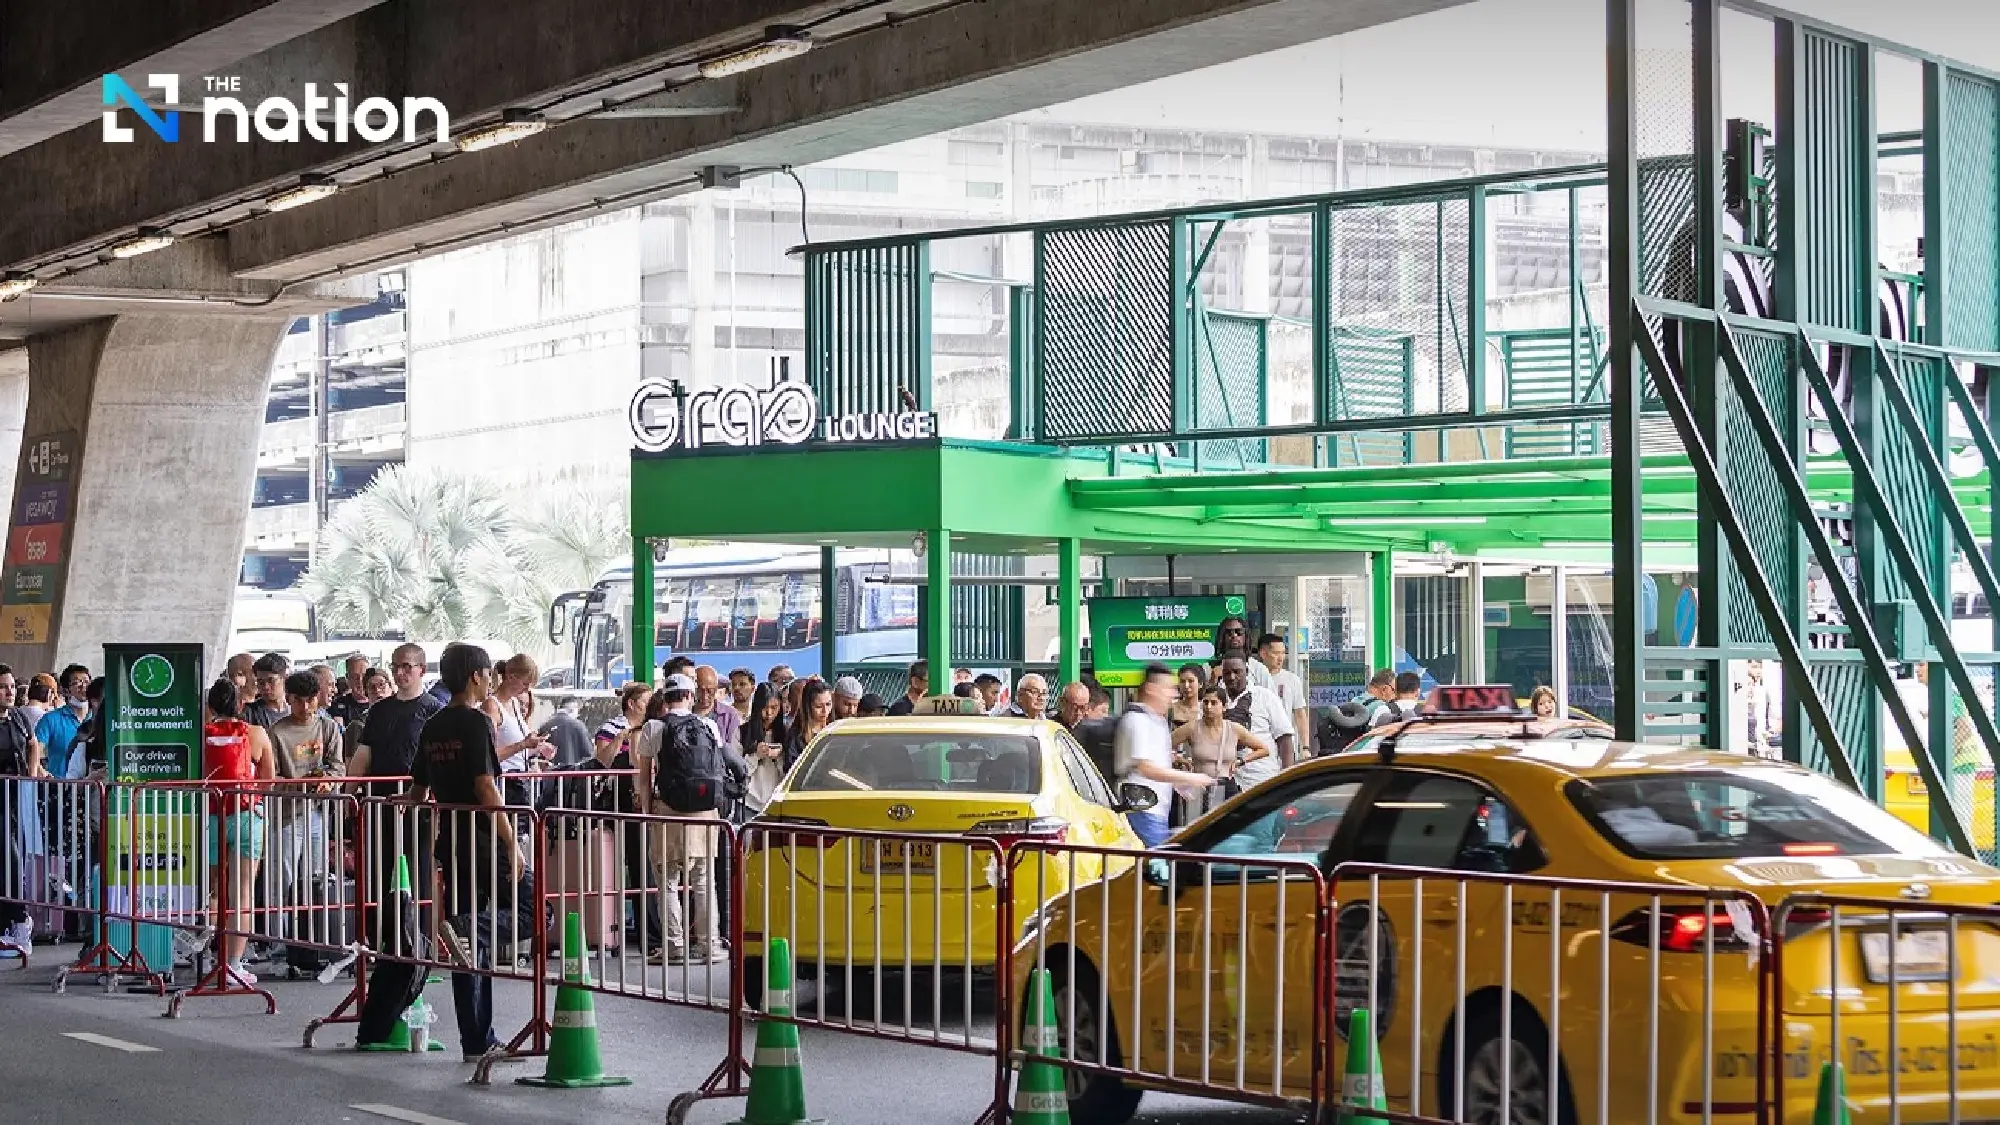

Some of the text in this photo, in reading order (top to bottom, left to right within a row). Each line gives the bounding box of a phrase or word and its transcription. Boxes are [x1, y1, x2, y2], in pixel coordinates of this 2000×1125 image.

[630, 355, 934, 452] Grab LOUNGE
[121, 705, 184, 716] Please wait
[932, 699, 961, 713] TAXI
[111, 719, 193, 732] just a moment!
[125, 750, 177, 761] Our driver
[120, 762, 182, 773] will arrive in
[1031, 1095, 1062, 1109] Grab
